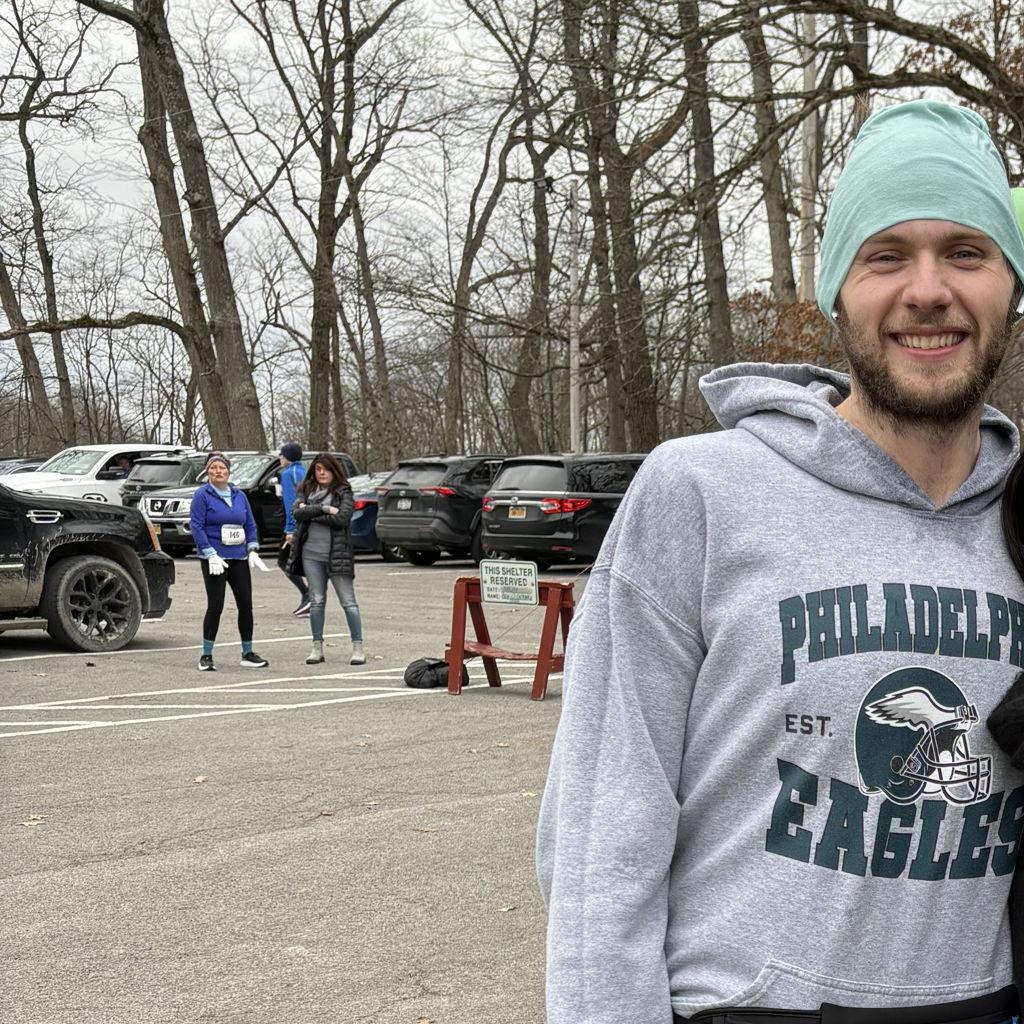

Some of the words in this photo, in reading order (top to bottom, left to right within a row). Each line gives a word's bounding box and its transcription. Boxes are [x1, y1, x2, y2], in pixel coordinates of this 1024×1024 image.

[485, 566, 501, 575] THIS
[502, 567, 533, 577] SHELTER
[490, 576, 528, 586] RESERVED
[785, 714, 833, 738] EST.
